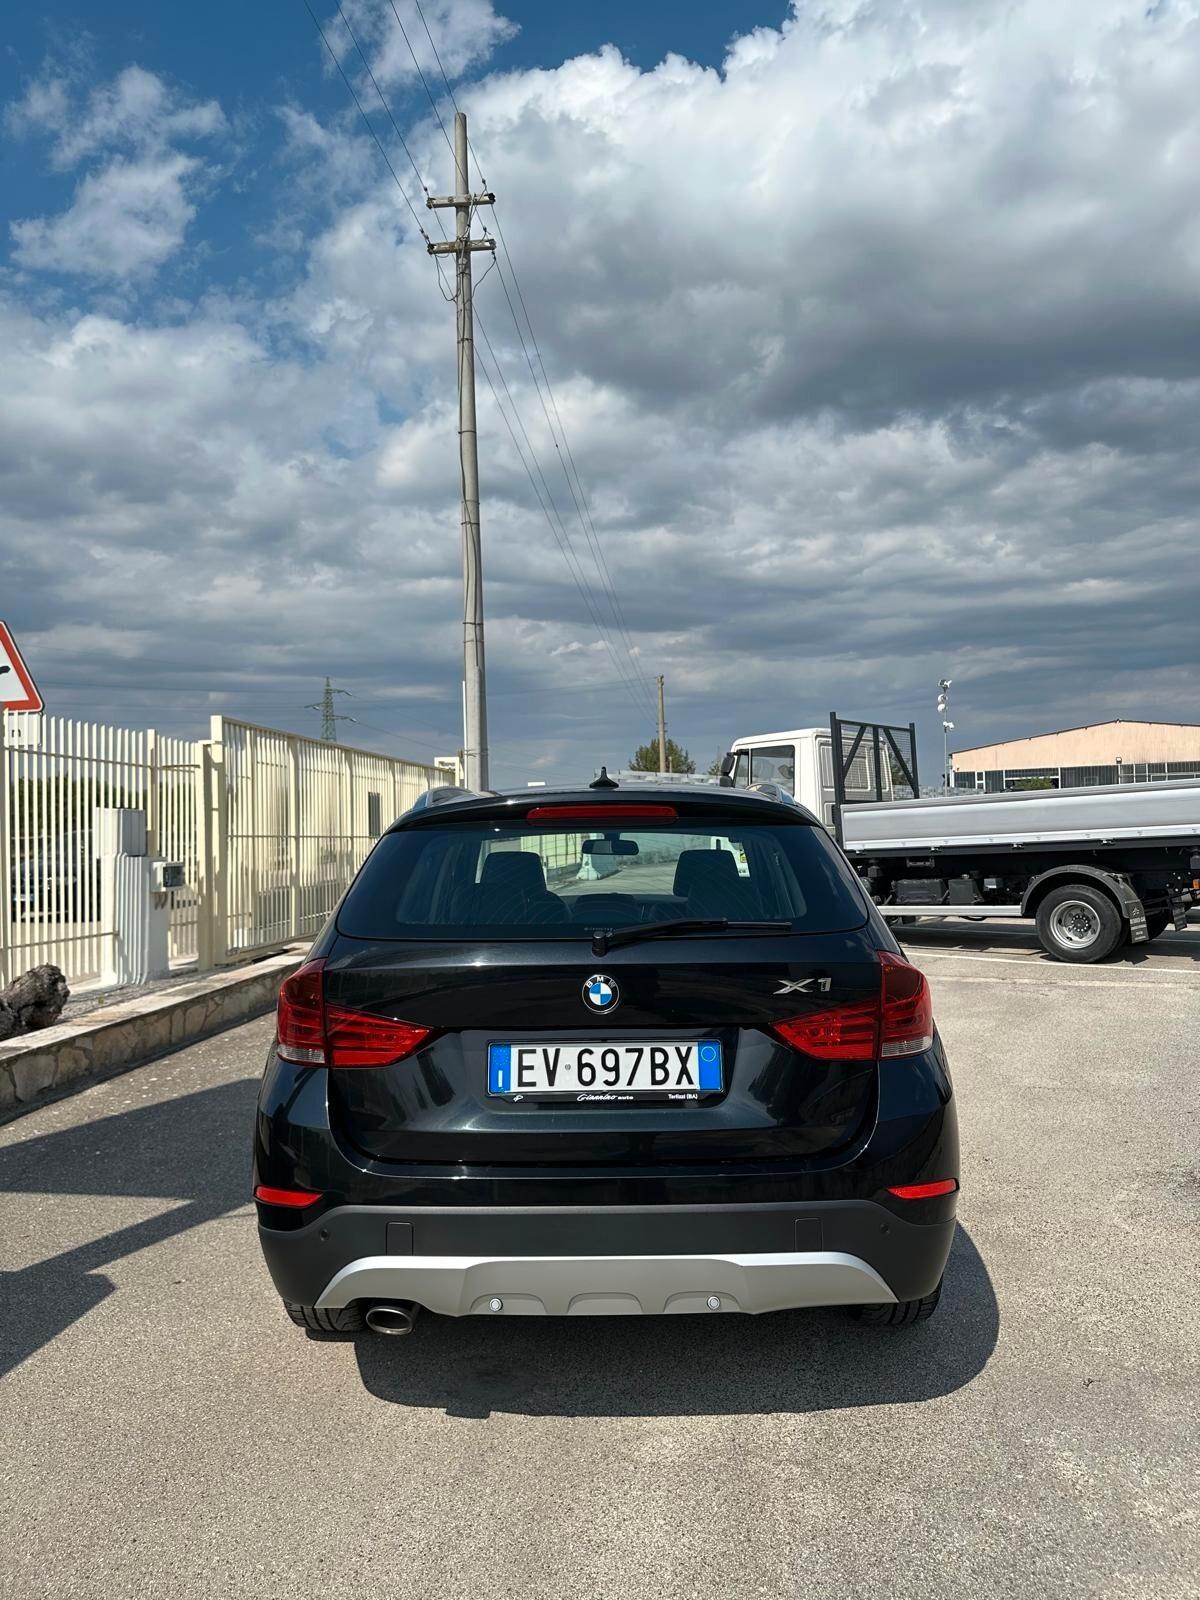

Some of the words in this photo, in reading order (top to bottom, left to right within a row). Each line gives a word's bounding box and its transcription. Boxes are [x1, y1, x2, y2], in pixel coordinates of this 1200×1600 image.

[584, 976, 616, 989] BMW
[772, 977, 832, 994] X1
[517, 1047, 561, 1088] EV
[576, 1046, 695, 1087] 697BX
[686, 1093, 698, 1101] (BA)
